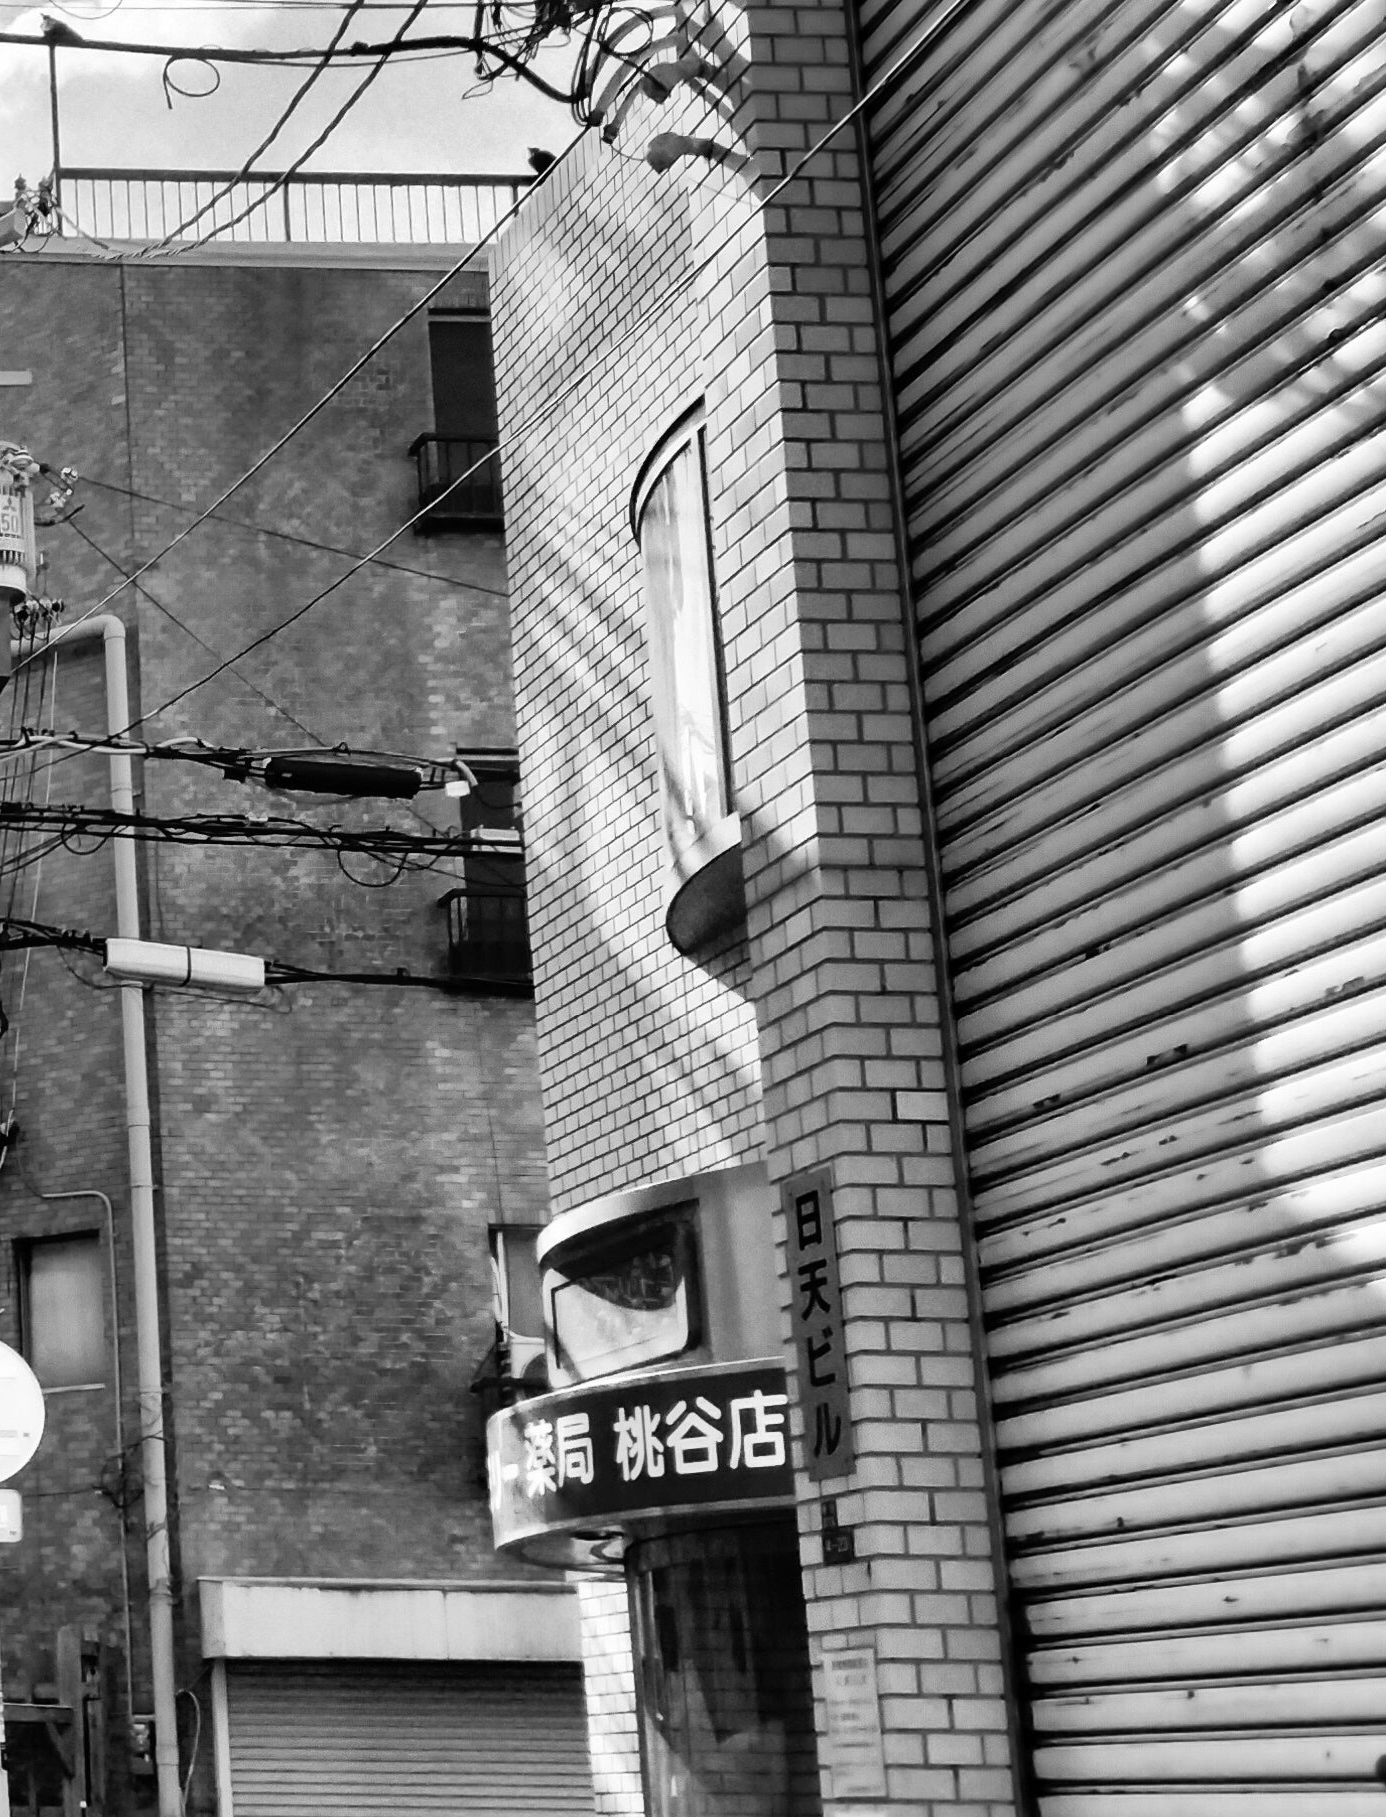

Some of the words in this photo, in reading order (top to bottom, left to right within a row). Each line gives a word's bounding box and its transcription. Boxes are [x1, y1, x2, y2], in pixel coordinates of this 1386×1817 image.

[795, 1190, 841, 1460] 日天ビル
[614, 1389, 789, 1481] 桃谷店
